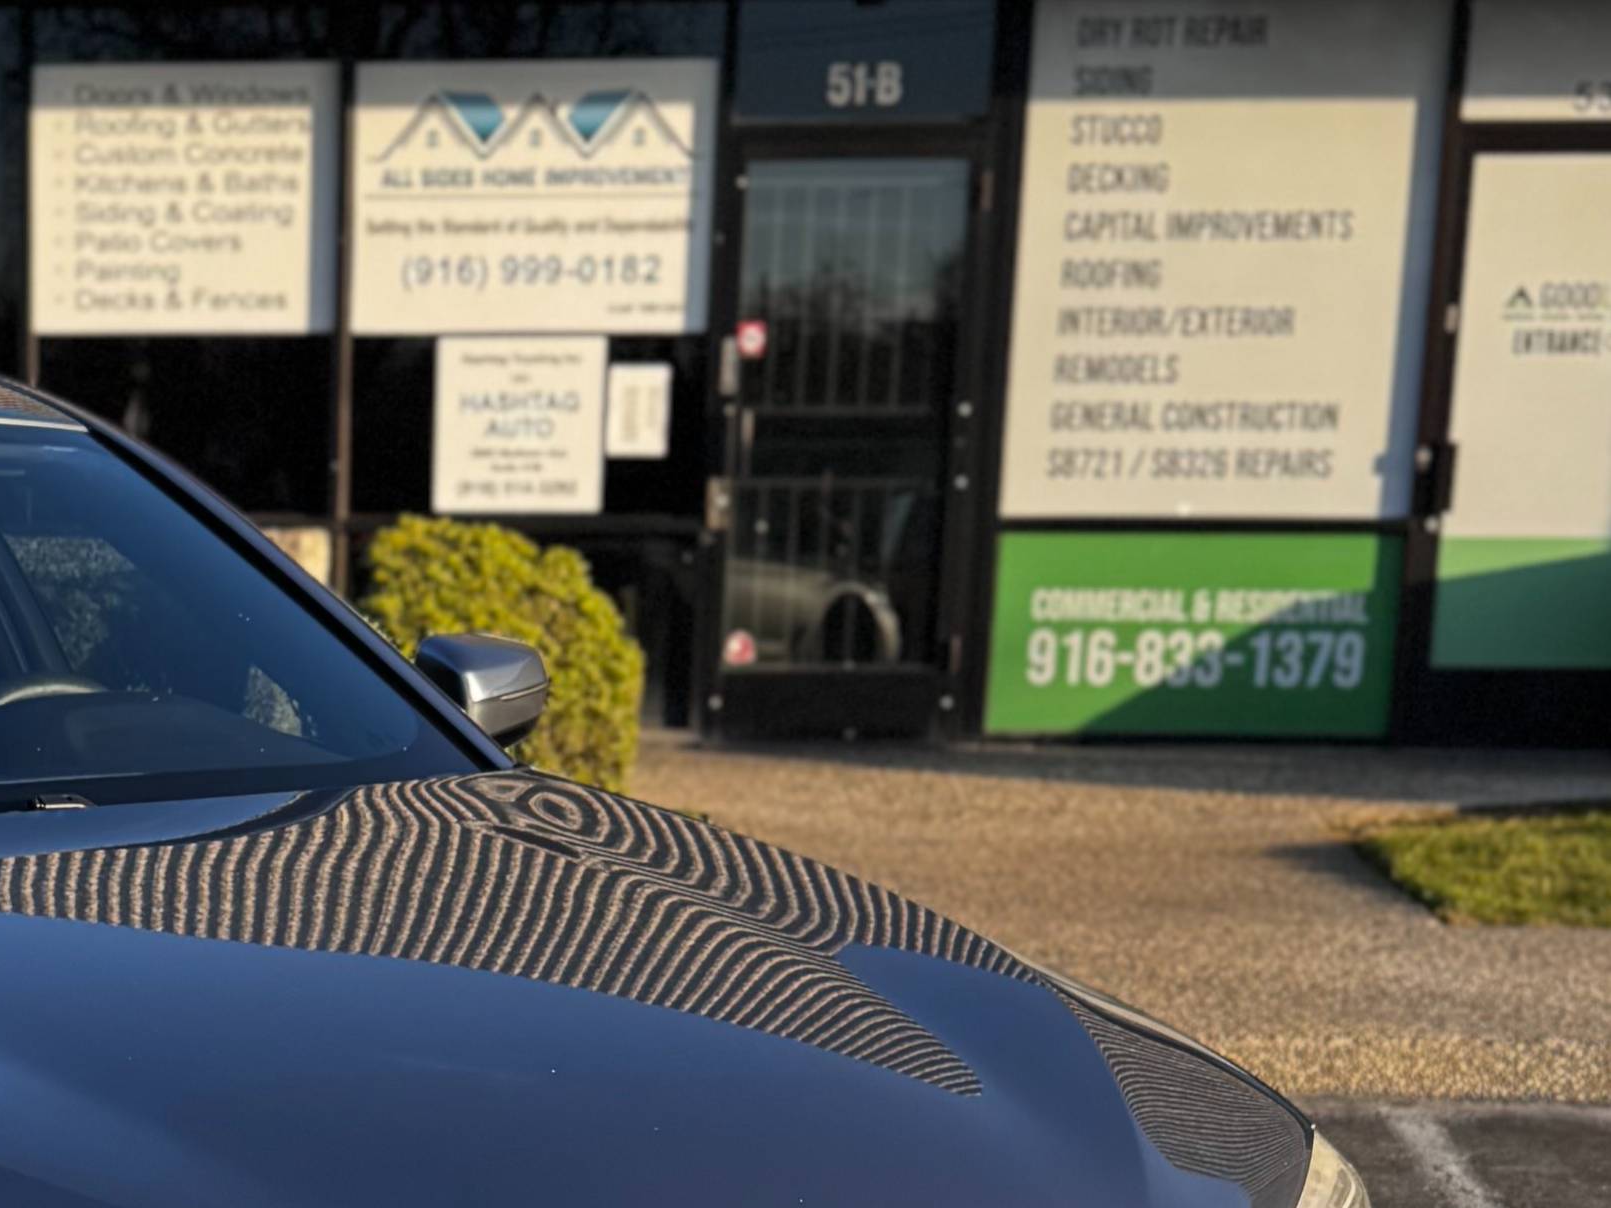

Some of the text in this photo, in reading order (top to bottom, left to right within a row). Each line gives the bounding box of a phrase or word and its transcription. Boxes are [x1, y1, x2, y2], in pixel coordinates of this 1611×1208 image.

[1077, 15, 1270, 47] DRY ROT REPAIR
[74, 80, 308, 105] Doors & Windows
[1073, 65, 1154, 96] SIDING
[75, 110, 312, 139] Roofing & Gutters
[1070, 114, 1163, 145] STUCCO
[75, 142, 304, 165] Custom Concrete
[75, 170, 299, 194] Kitchens & Baths
[380, 169, 413, 188] ALL
[482, 168, 536, 187] HOME
[1067, 163, 1170, 194] DECKING
[75, 201, 293, 228] Siding & Coating
[1064, 210, 1355, 242] CAPITAL IMPROVEMENTS
[74, 230, 243, 254] Patio Covers
[74, 260, 181, 287] Painting
[402, 254, 661, 291] (916) 999-0182
[1061, 259, 1161, 290] ROOFING
[75, 288, 289, 312] Decks & Fences
[1057, 306, 1295, 337] INTERIOR/EXTERIOR
[1054, 355, 1179, 385] REMODELS
[460, 391, 581, 412] HASHTAG
[486, 417, 556, 438] AUTO
[1050, 403, 1340, 432] GENERAL CONSTRUCTION
[1130, 449, 1146, 479] /
[1235, 450, 1334, 479] REPAIRS
[1030, 588, 1370, 624] COMMERCIAL & RESIDENTIAL
[1027, 628, 1368, 688] 916-833-1379
